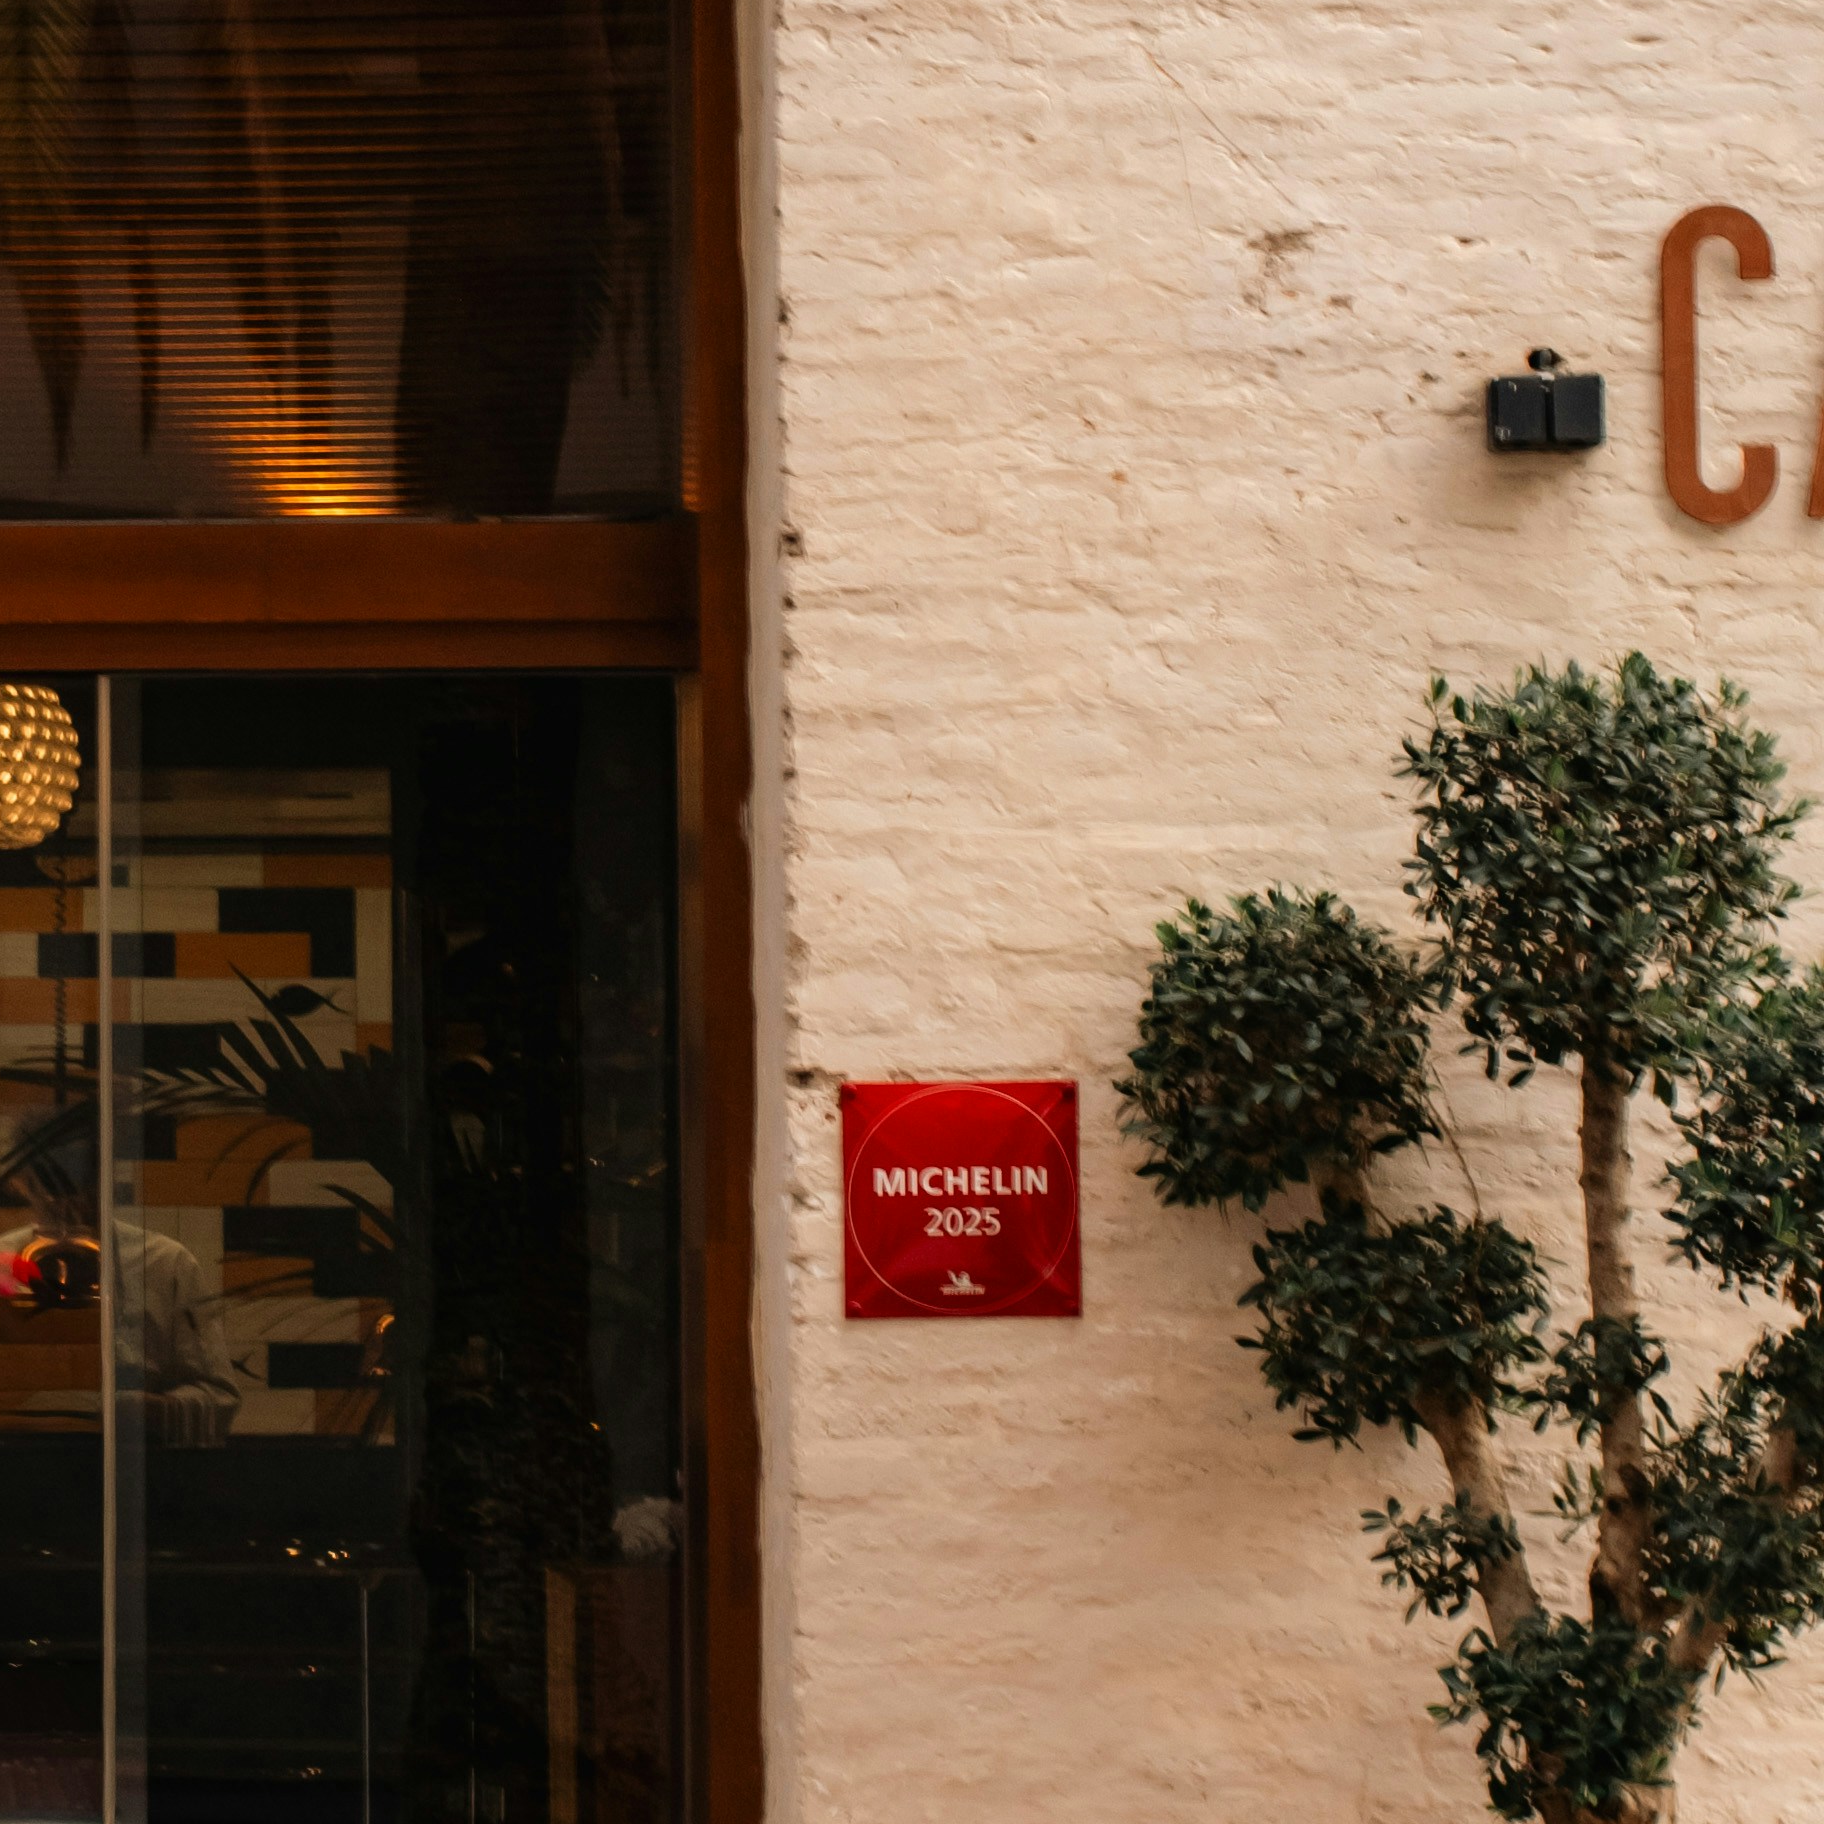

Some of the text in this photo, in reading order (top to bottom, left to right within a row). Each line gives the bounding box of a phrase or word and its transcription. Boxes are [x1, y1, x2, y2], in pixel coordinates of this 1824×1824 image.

[1662, 205, 1824, 524] C
[873, 1166, 1048, 1197] MICHELIN
[924, 1207, 1001, 1237] 2025
